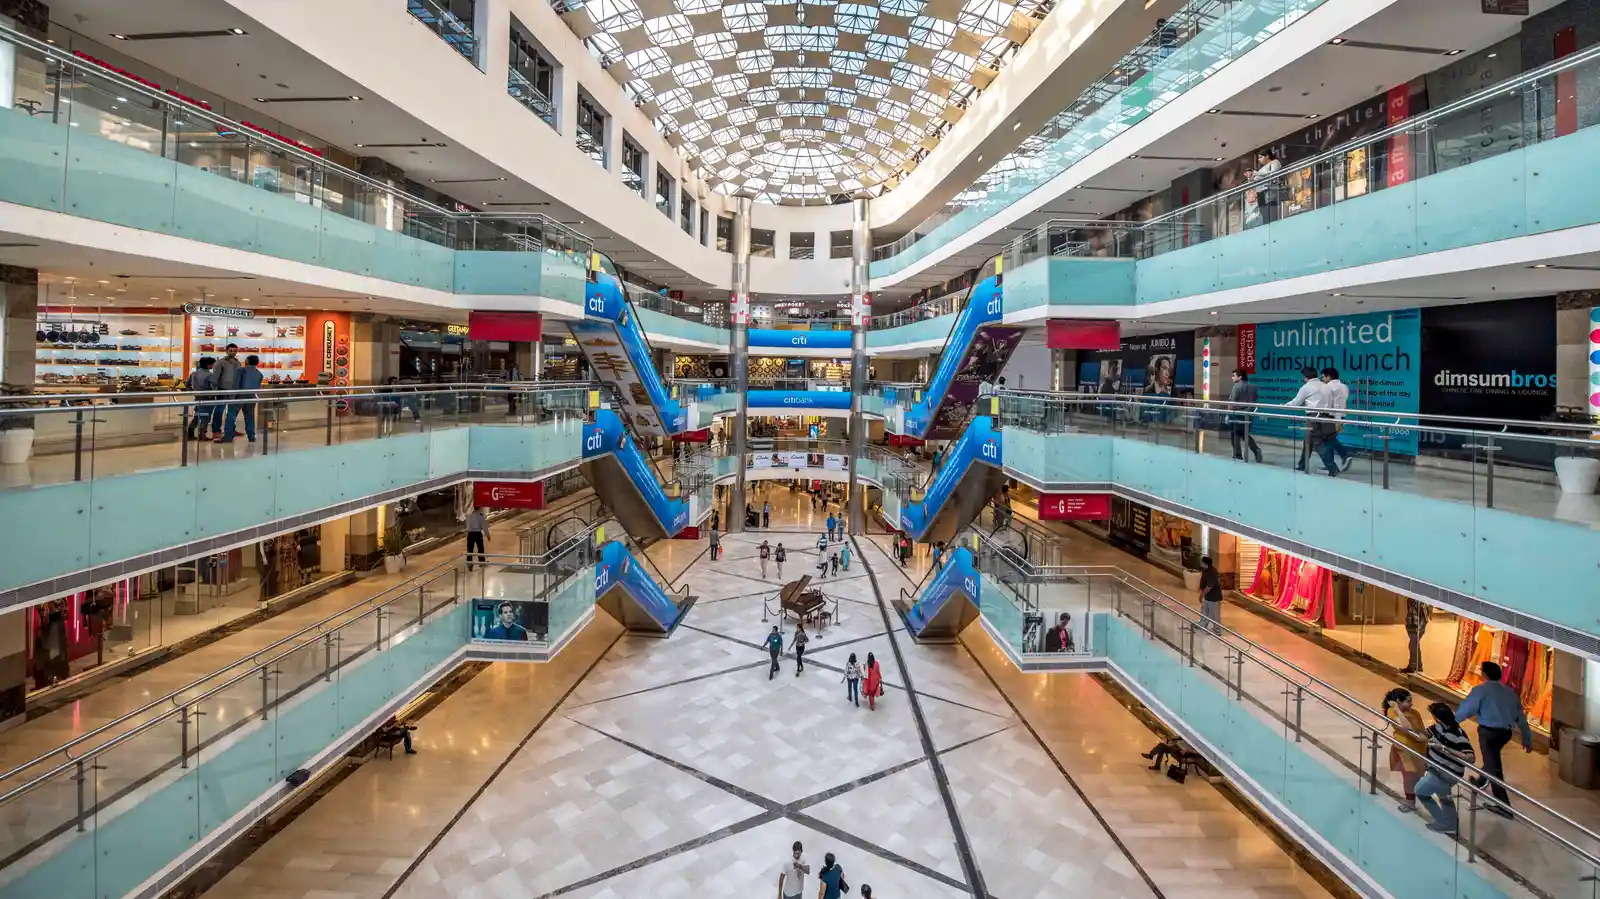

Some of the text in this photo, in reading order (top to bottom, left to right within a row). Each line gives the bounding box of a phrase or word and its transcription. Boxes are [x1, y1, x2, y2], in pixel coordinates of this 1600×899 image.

[1305, 102, 1385, 144] thriller
[212, 307, 251, 317] CREUSET
[588, 295, 604, 313] citi
[987, 296, 1001, 315] citi
[791, 335, 807, 345] citi
[1273, 314, 1392, 348] unlimited
[325, 326, 333, 369] LE CREUSET
[1150, 338, 1169, 348] JUMBO
[1246, 329, 1255, 368] special
[1261, 346, 1410, 372] dimsum lunch
[783, 396, 814, 404] citibank
[587, 431, 602, 451] citi
[982, 443, 997, 459] citi
[491, 487, 499, 500] G
[1058, 499, 1065, 514] G
[595, 567, 609, 590] citi
[964, 576, 977, 598] citi
